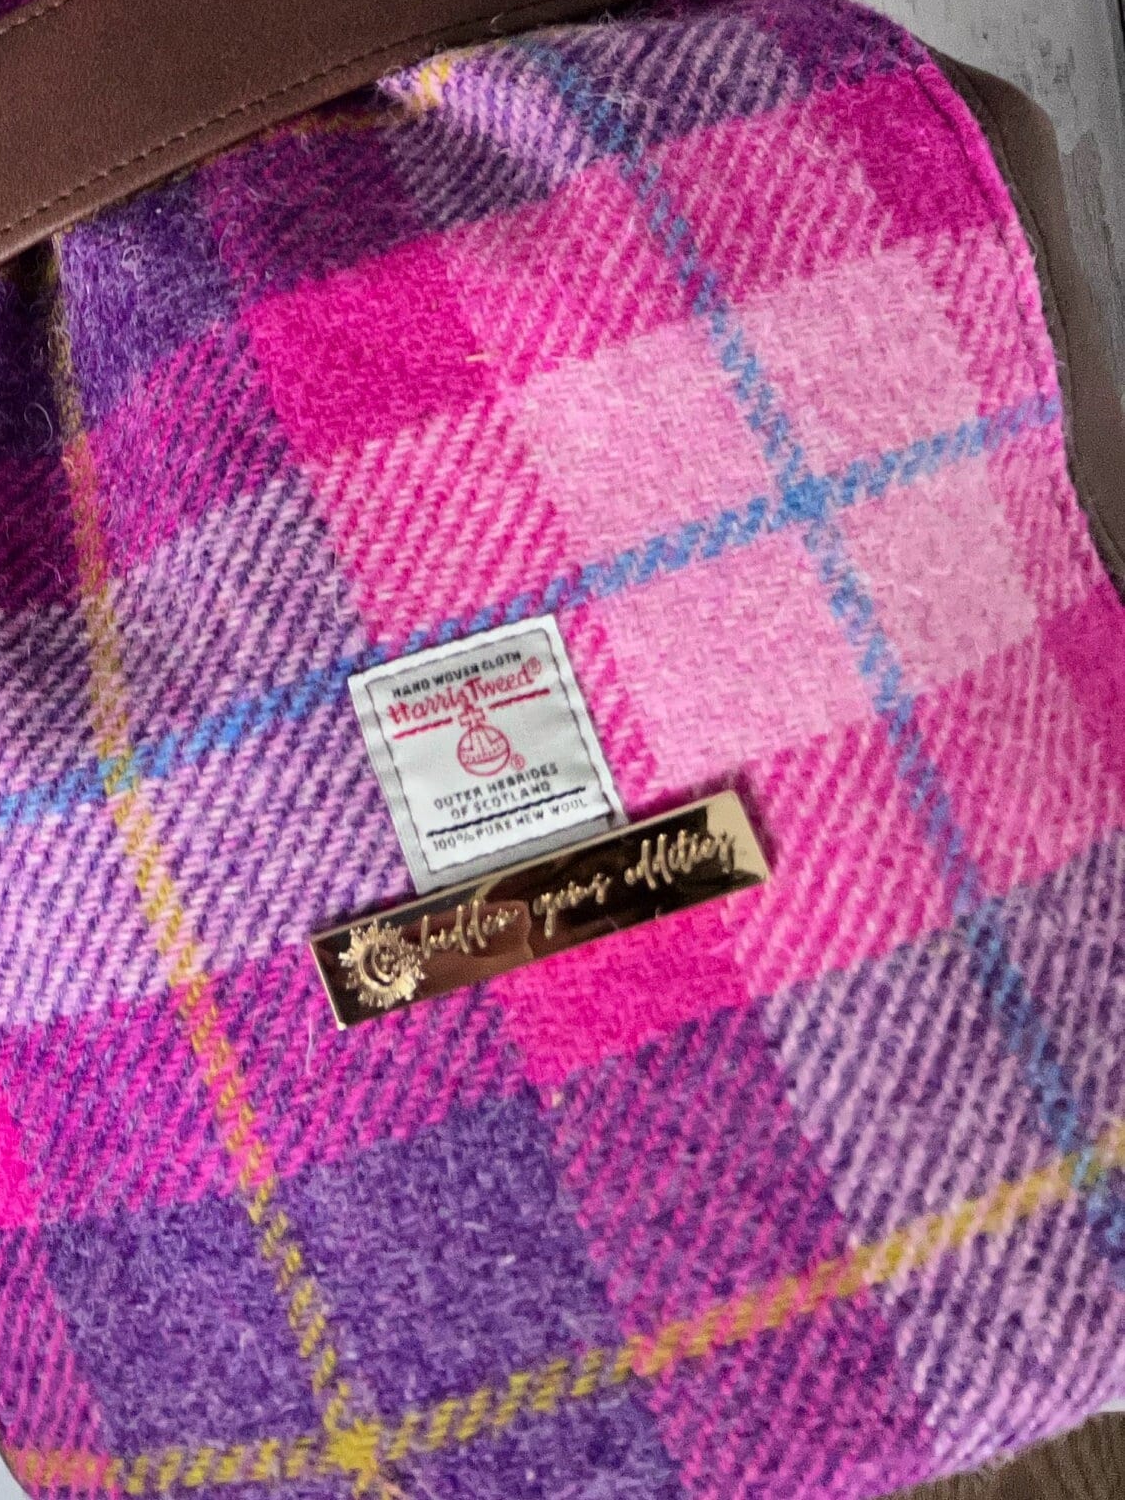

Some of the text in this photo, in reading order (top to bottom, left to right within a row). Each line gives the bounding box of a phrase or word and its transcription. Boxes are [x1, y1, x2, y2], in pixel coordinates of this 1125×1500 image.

[392, 652, 522, 699] HAND WOVEN CLOTH
[387, 686, 469, 725] Harris
[433, 762, 559, 811] OUTER HEBRIDES
[451, 781, 551, 820] OF SCOTLAND
[432, 798, 588, 851] 100% PURE NEW WOOL
